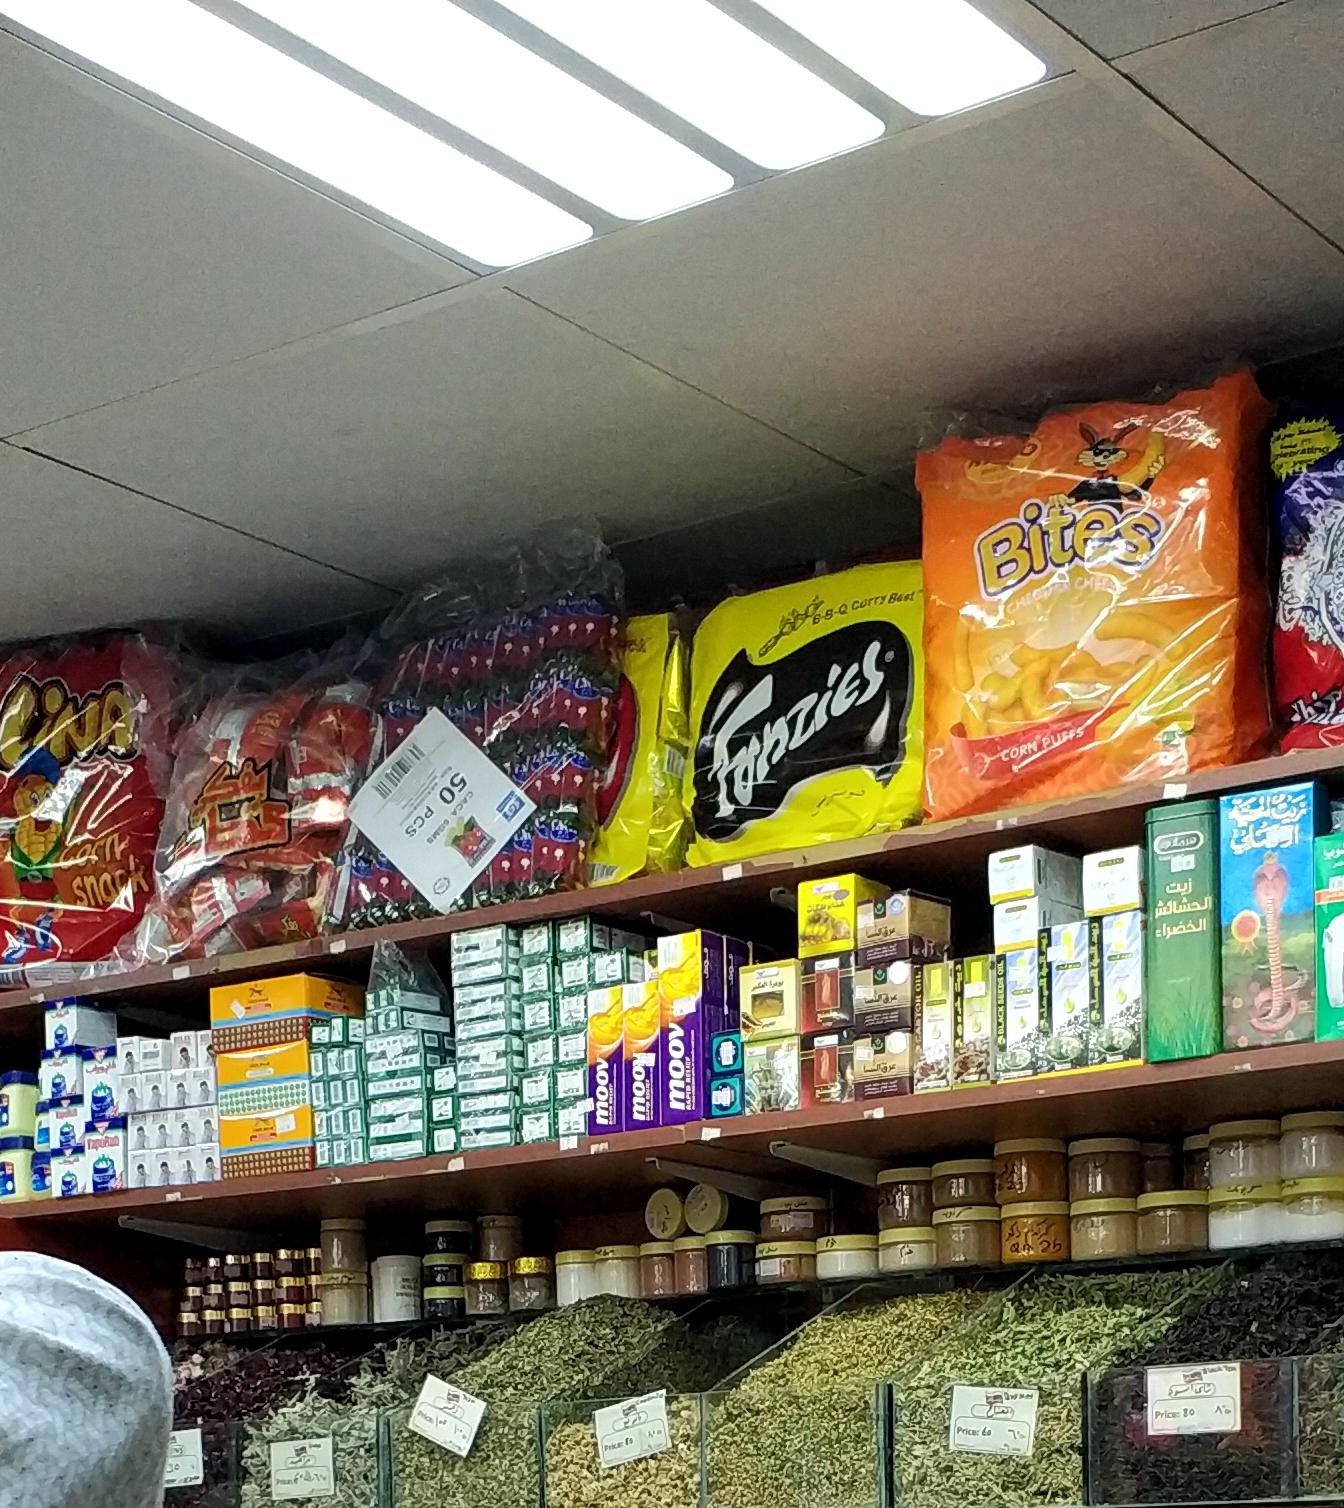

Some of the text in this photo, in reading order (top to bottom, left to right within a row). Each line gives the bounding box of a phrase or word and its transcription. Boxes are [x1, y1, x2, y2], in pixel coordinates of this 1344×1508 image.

[974, 498, 1166, 600] Bites
[1000, 725, 1087, 763] CORN PUFFS
[438, 771, 468, 806] 50
[595, 1056, 610, 1126] moov
[668, 1021, 686, 1111] moov
